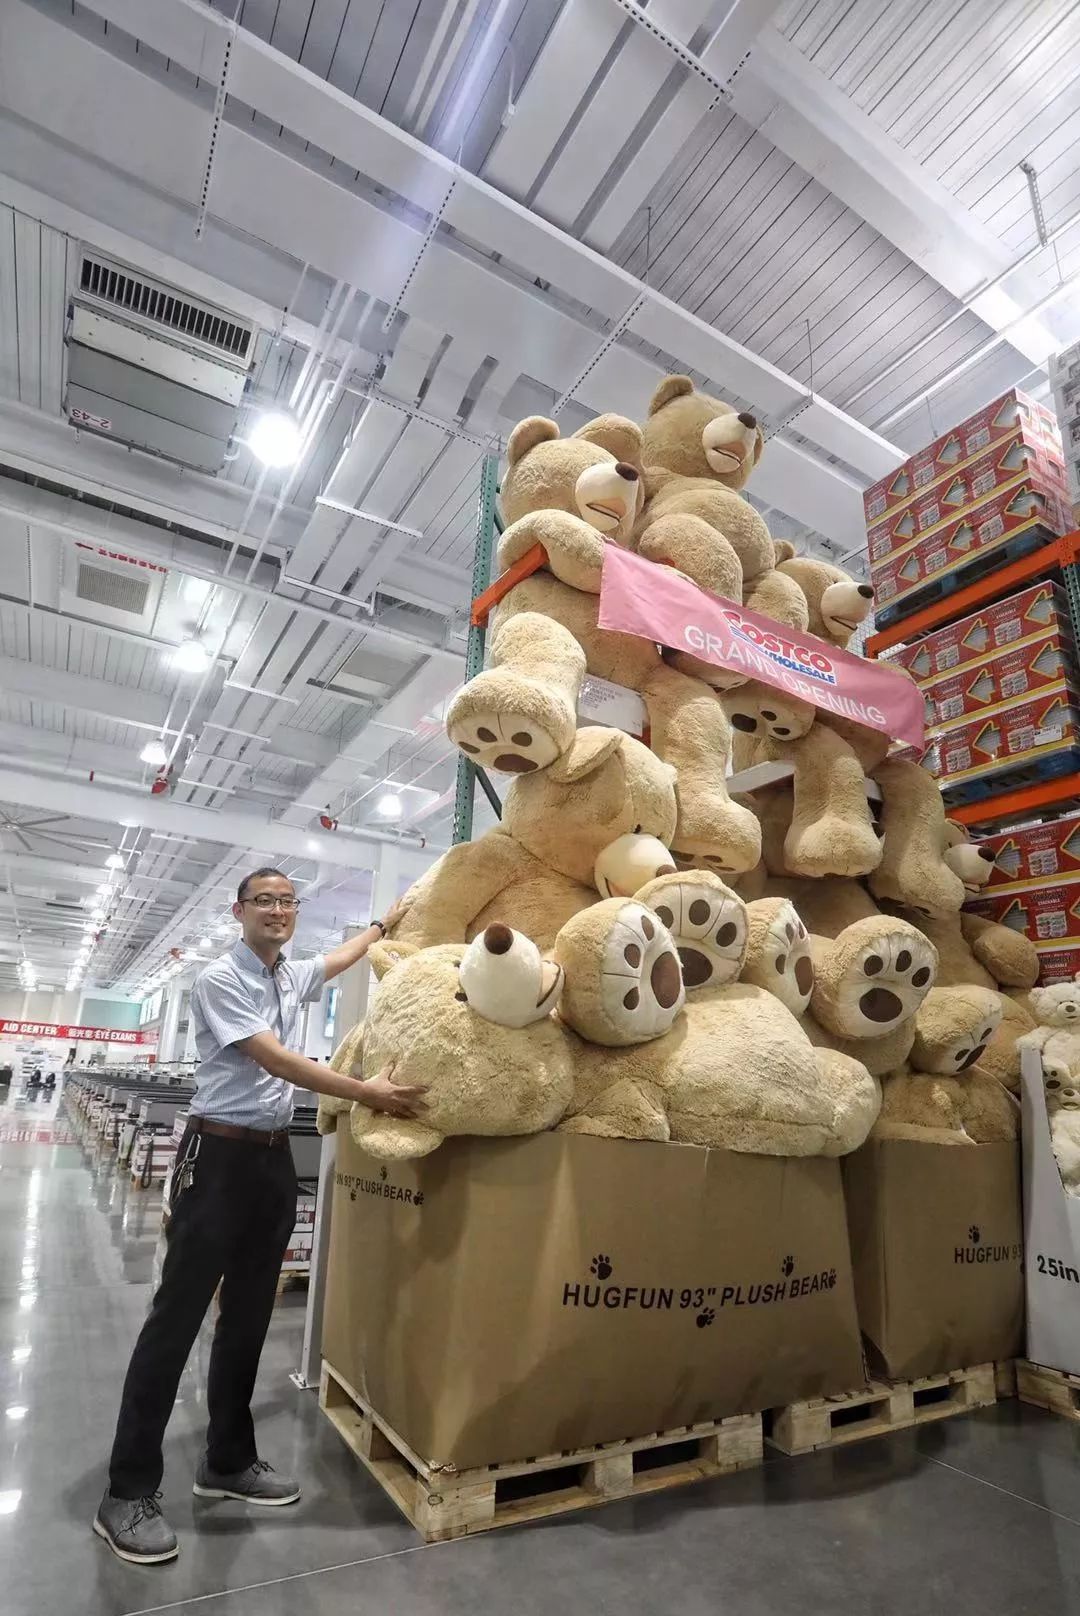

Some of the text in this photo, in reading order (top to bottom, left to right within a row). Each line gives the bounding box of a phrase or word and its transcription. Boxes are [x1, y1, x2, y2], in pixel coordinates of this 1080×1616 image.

[72, 408, 109, 428] 2-43
[722, 609, 833, 673] COSTCO
[684, 625, 886, 725] GRAND OPENING
[2, 1023, 57, 1036] AID CENTER
[95, 1030, 110, 1040] EYE
[111, 1032, 136, 1042] EXAMS
[356, 1177, 382, 1196] PLUSH
[384, 1185, 412, 1202] BEAR
[954, 1246, 1010, 1263] HUGFUN
[563, 1271, 829, 1309] HUGFUN 93" PLUSH BEAR
